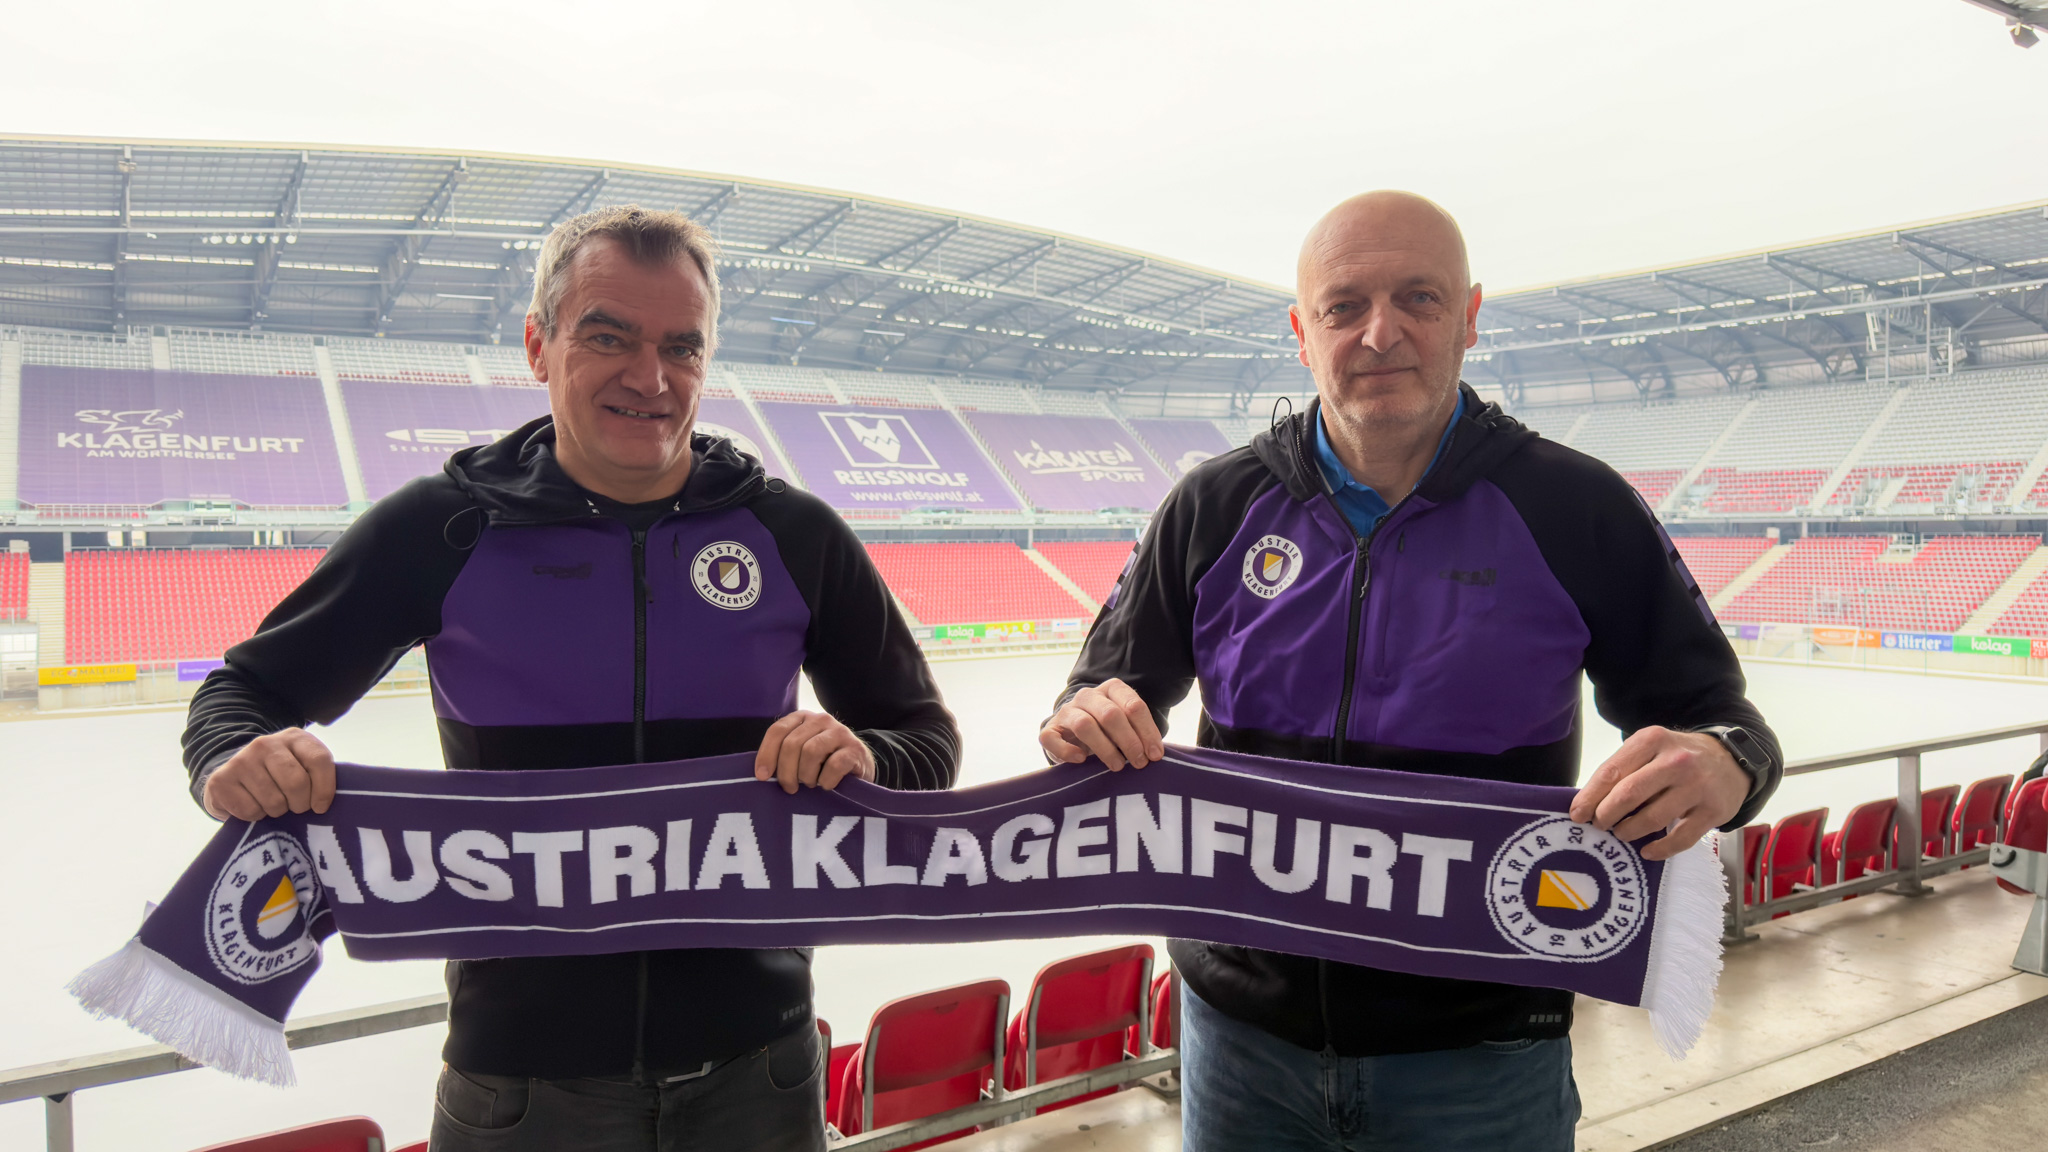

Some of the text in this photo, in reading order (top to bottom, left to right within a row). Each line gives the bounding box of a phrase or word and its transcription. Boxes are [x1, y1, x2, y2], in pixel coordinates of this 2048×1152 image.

[57, 432, 304, 453] KLAGENFURT
[86, 449, 115, 458] AM
[833, 470, 970, 487] REISSWOLF
[1080, 471, 1145, 482] SPORT
[850, 489, 985, 503] www.reisswolf.at
[700, 546, 754, 567] AUSTRIA
[1251, 537, 1299, 559] AUSTRIA
[702, 583, 756, 604] KLAGENFURT
[1245, 573, 1292, 596] KLAGENFURT
[1898, 634, 1942, 650] Hirter
[1971, 637, 2012, 655] kelag
[1568, 826, 1584, 844] 20
[306, 793, 1474, 917] AUSTRIA KLAGENFURT
[230, 871, 248, 888] 19
[1501, 835, 1551, 936] AUSTRIA
[1581, 838, 1636, 949] KLAGENFURT
[219, 902, 297, 973] KLAGENFURT
[1549, 934, 1566, 947] 19
